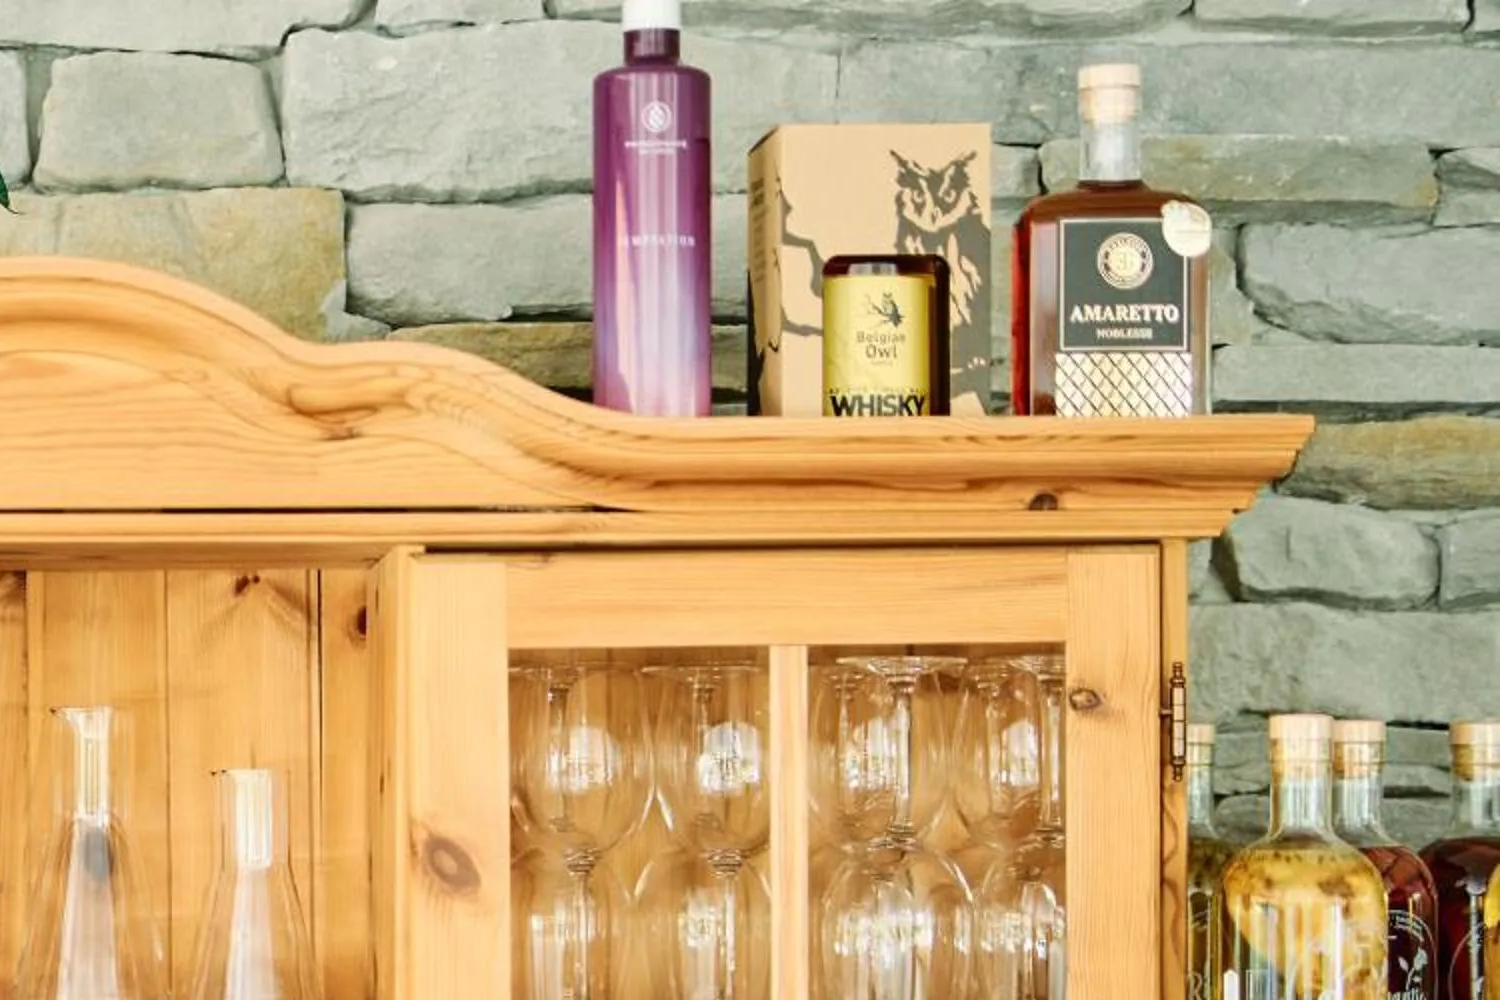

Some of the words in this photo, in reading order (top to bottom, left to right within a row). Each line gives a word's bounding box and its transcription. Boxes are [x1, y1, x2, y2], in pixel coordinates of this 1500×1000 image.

[1070, 303, 1180, 324] AMARETTO
[856, 330, 906, 345] Belgian
[865, 343, 898, 359] Owl
[829, 393, 925, 417] WHISKY
